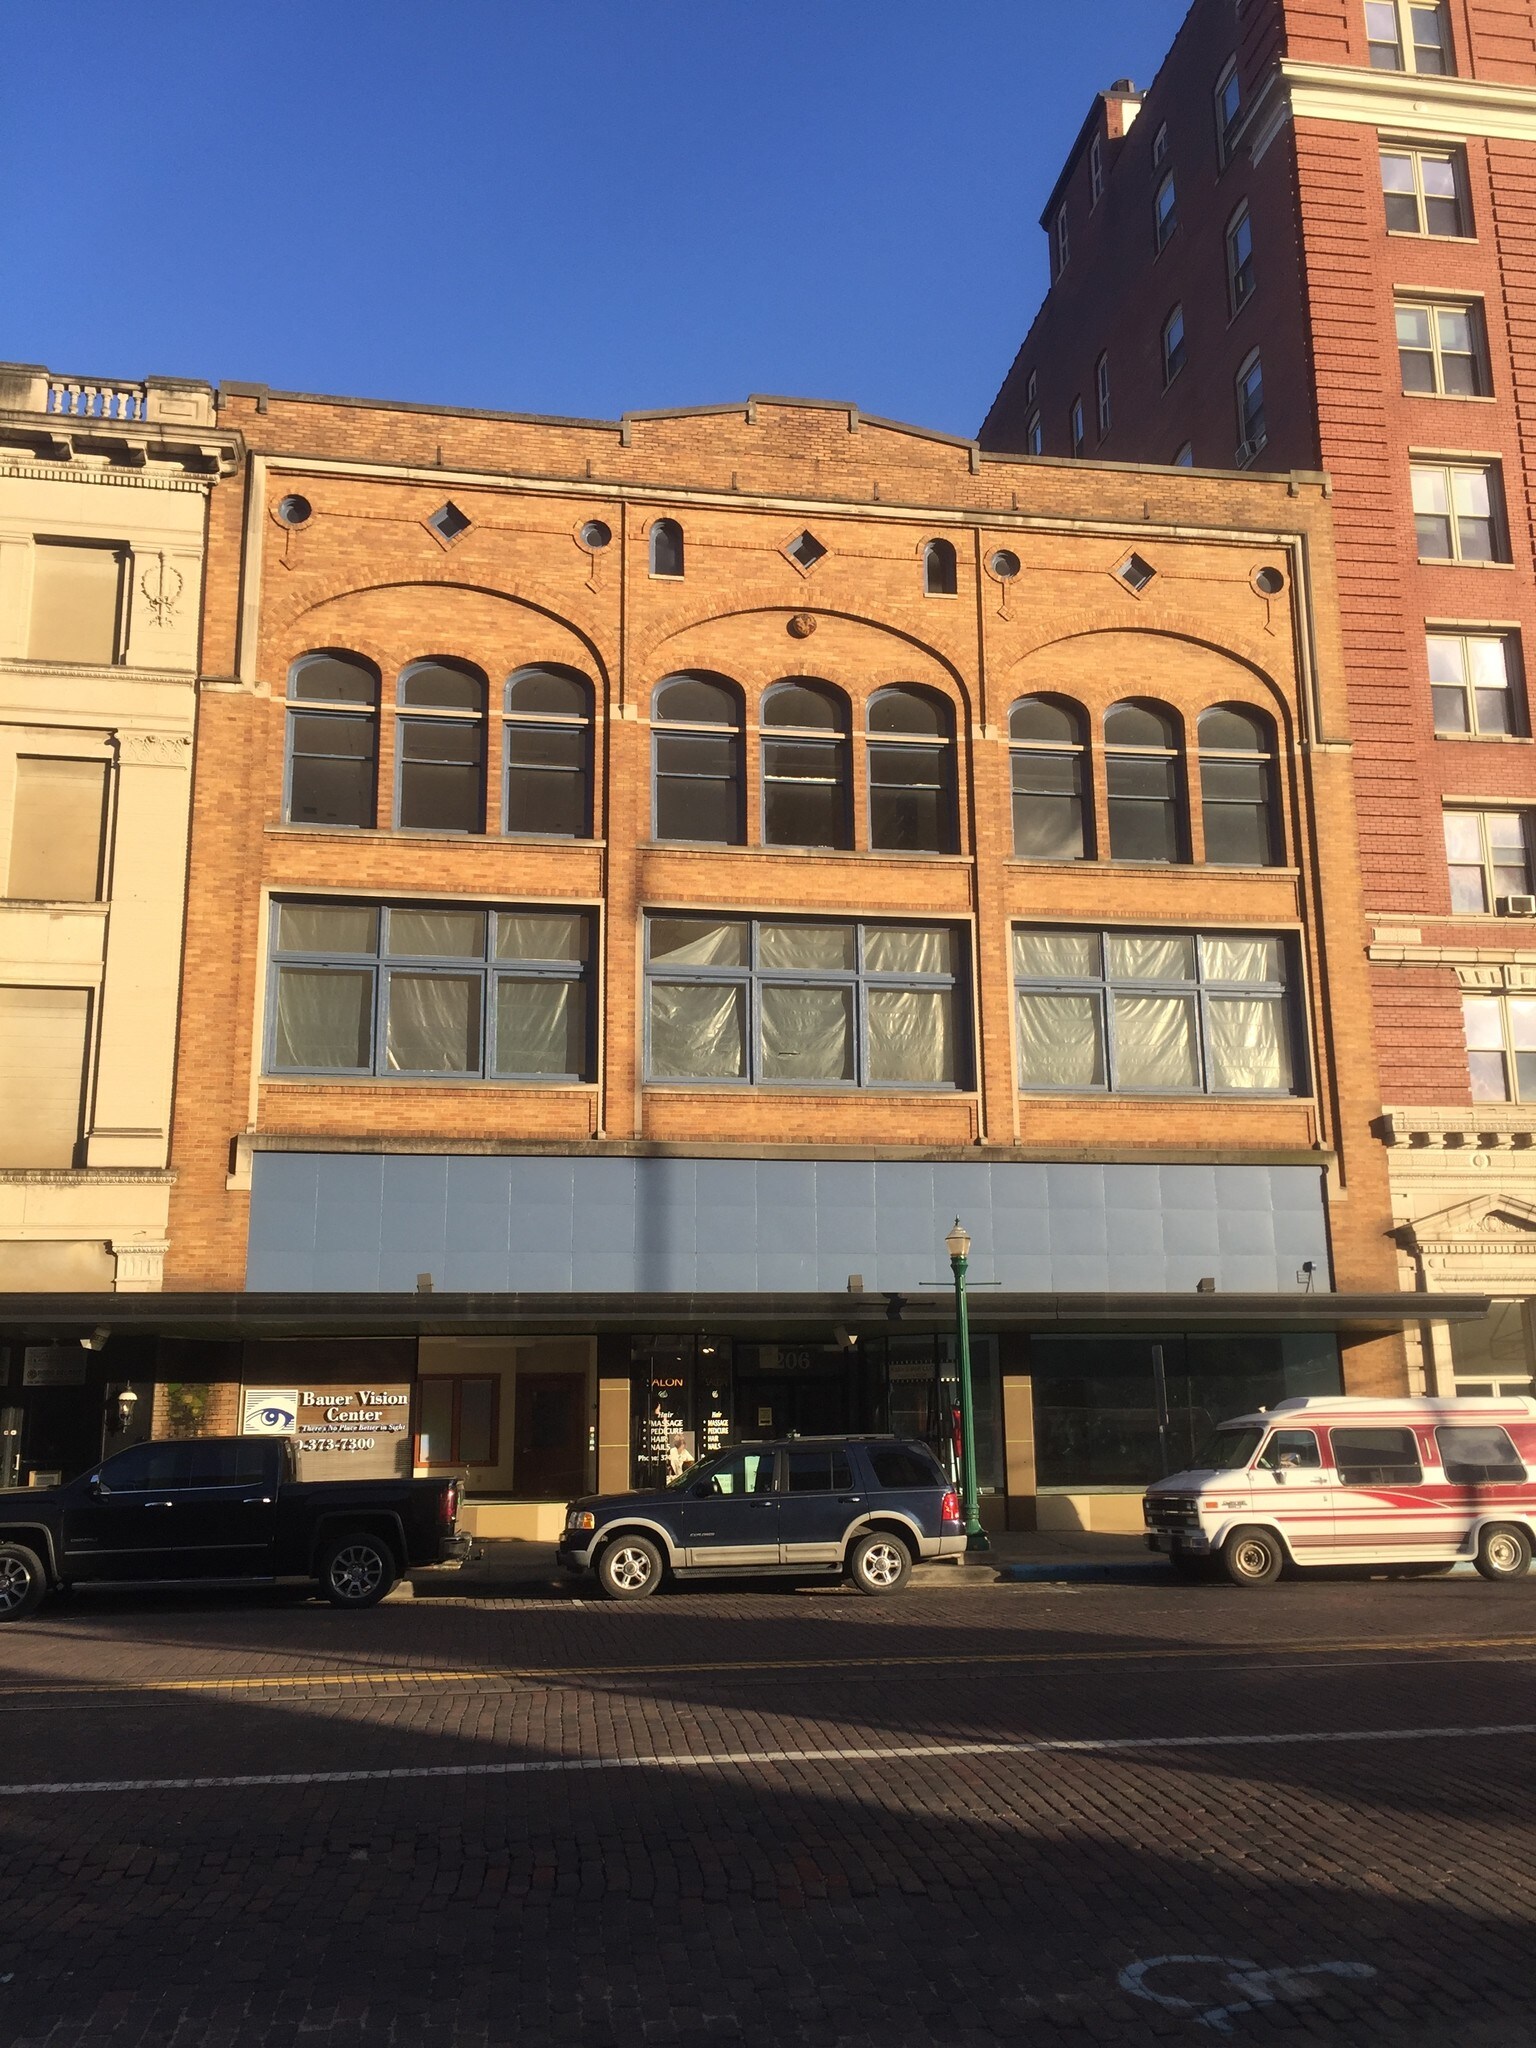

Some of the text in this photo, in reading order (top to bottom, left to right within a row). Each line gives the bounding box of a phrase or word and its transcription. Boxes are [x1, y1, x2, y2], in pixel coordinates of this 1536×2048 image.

[302, 1390, 408, 1406] Bauer Vision
[327, 1407, 383, 1421] Center
[650, 1419, 684, 1427] MASSAGE
[707, 1419, 729, 1427] MASSAGE
[328, 1424, 337, 1432] No
[339, 1424, 358, 1432] Place
[388, 1423, 406, 1432] Sight
[650, 1427, 684, 1435] PEDICURE
[707, 1427, 729, 1435] PEDICURE
[650, 1435, 669, 1443] HAIR
[650, 1443, 671, 1451] NAILS
